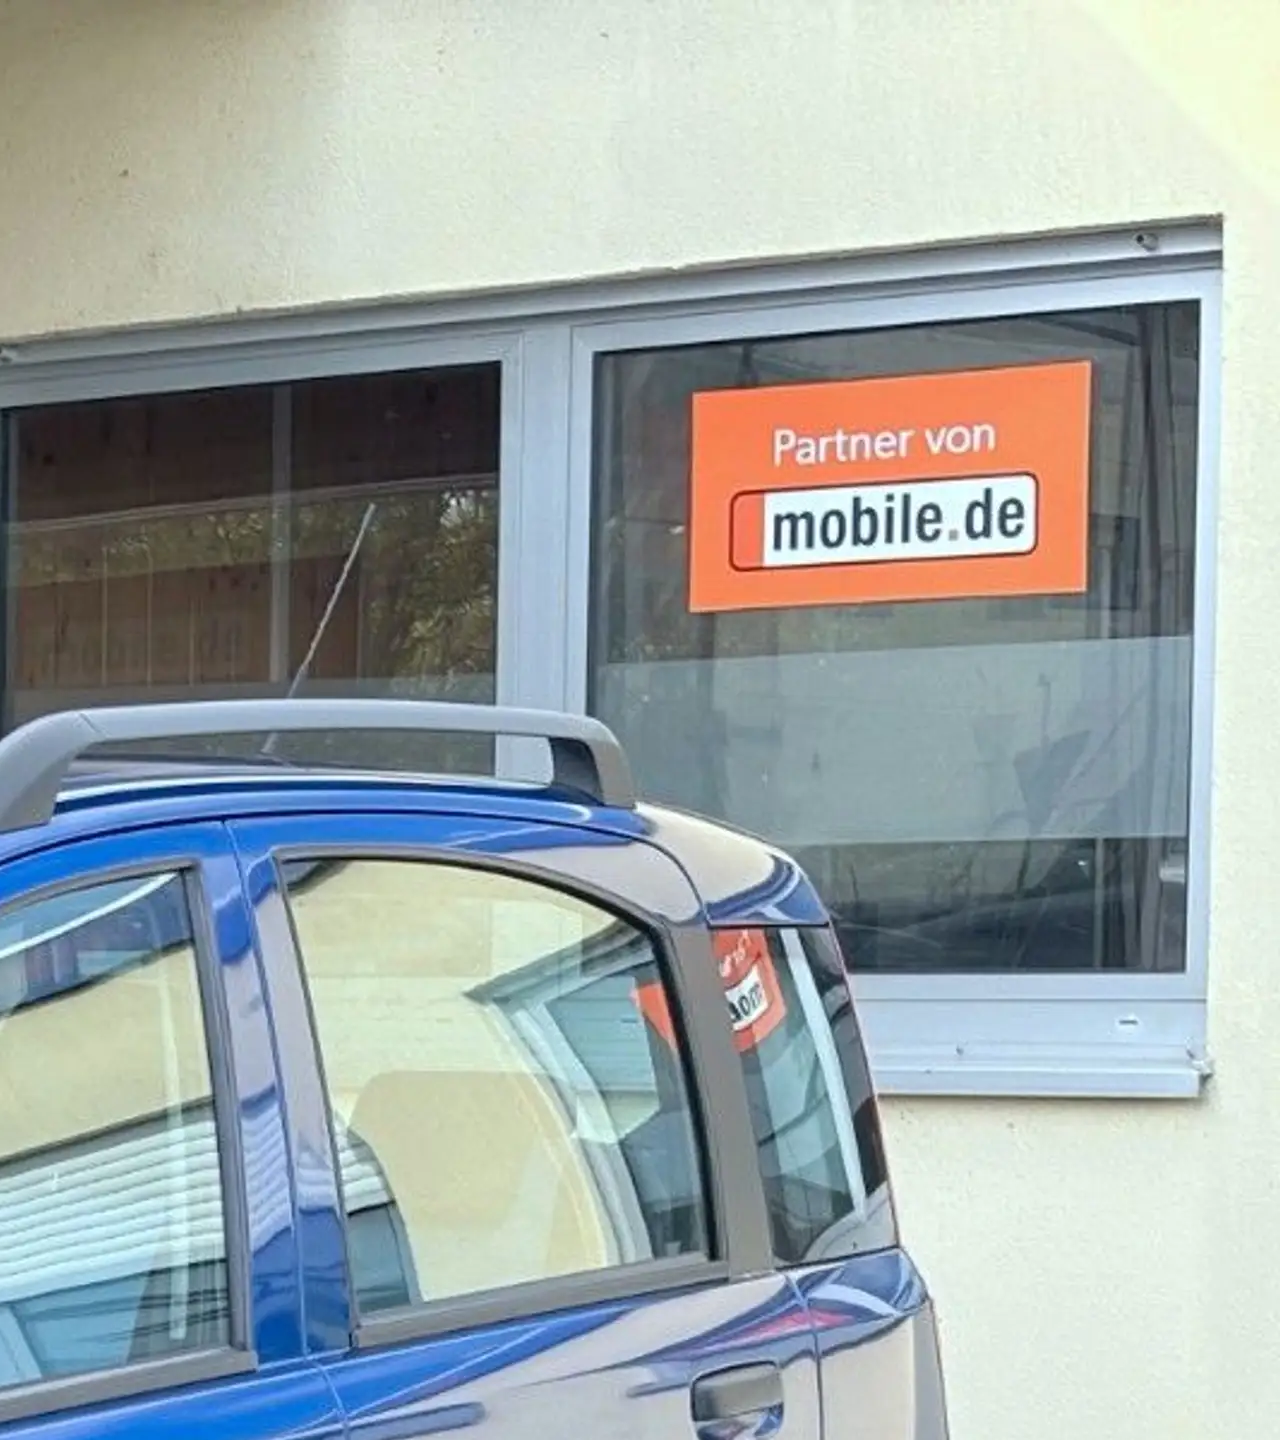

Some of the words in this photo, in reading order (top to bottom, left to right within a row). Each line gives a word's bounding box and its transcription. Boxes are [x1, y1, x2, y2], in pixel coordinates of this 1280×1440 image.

[772, 426, 916, 467] Partner
[925, 423, 996, 455] von
[772, 487, 1026, 552] mobile.de
